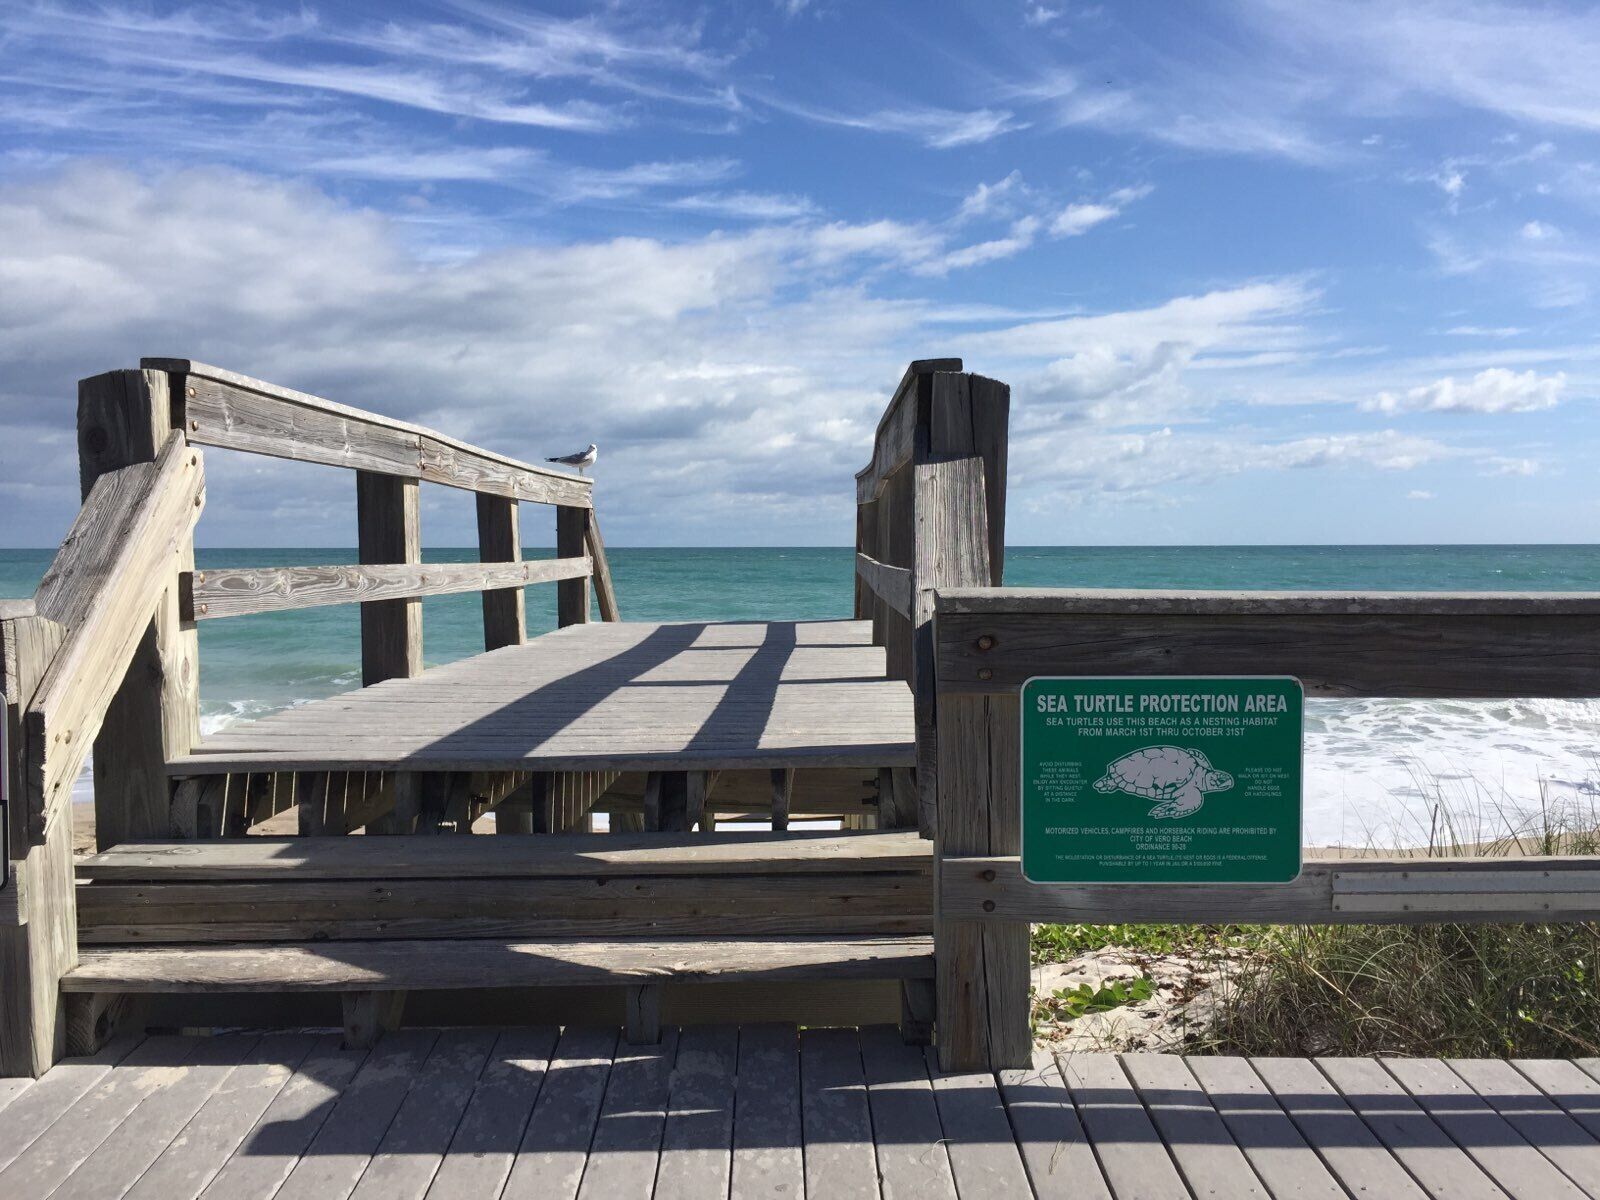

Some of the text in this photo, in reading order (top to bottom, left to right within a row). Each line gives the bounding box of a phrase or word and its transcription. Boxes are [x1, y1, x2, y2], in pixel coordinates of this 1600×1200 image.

[1037, 694, 1288, 713] SEA TURTLE PROTECTION AREA
[1046, 717, 1278, 726] SEA TURTLES USE THIS BEACH AS A NESTING HABITAT
[1078, 728, 1245, 736] FROM MARCH 1ST THRU OCTOBER 31ST
[1045, 827, 1277, 835] MOTORIZED VEHICLES, CAMPFIRES AND HORSEBACK RIDING ARE PROHIBITED BY
[1136, 843, 1170, 851] ORDINANCE
